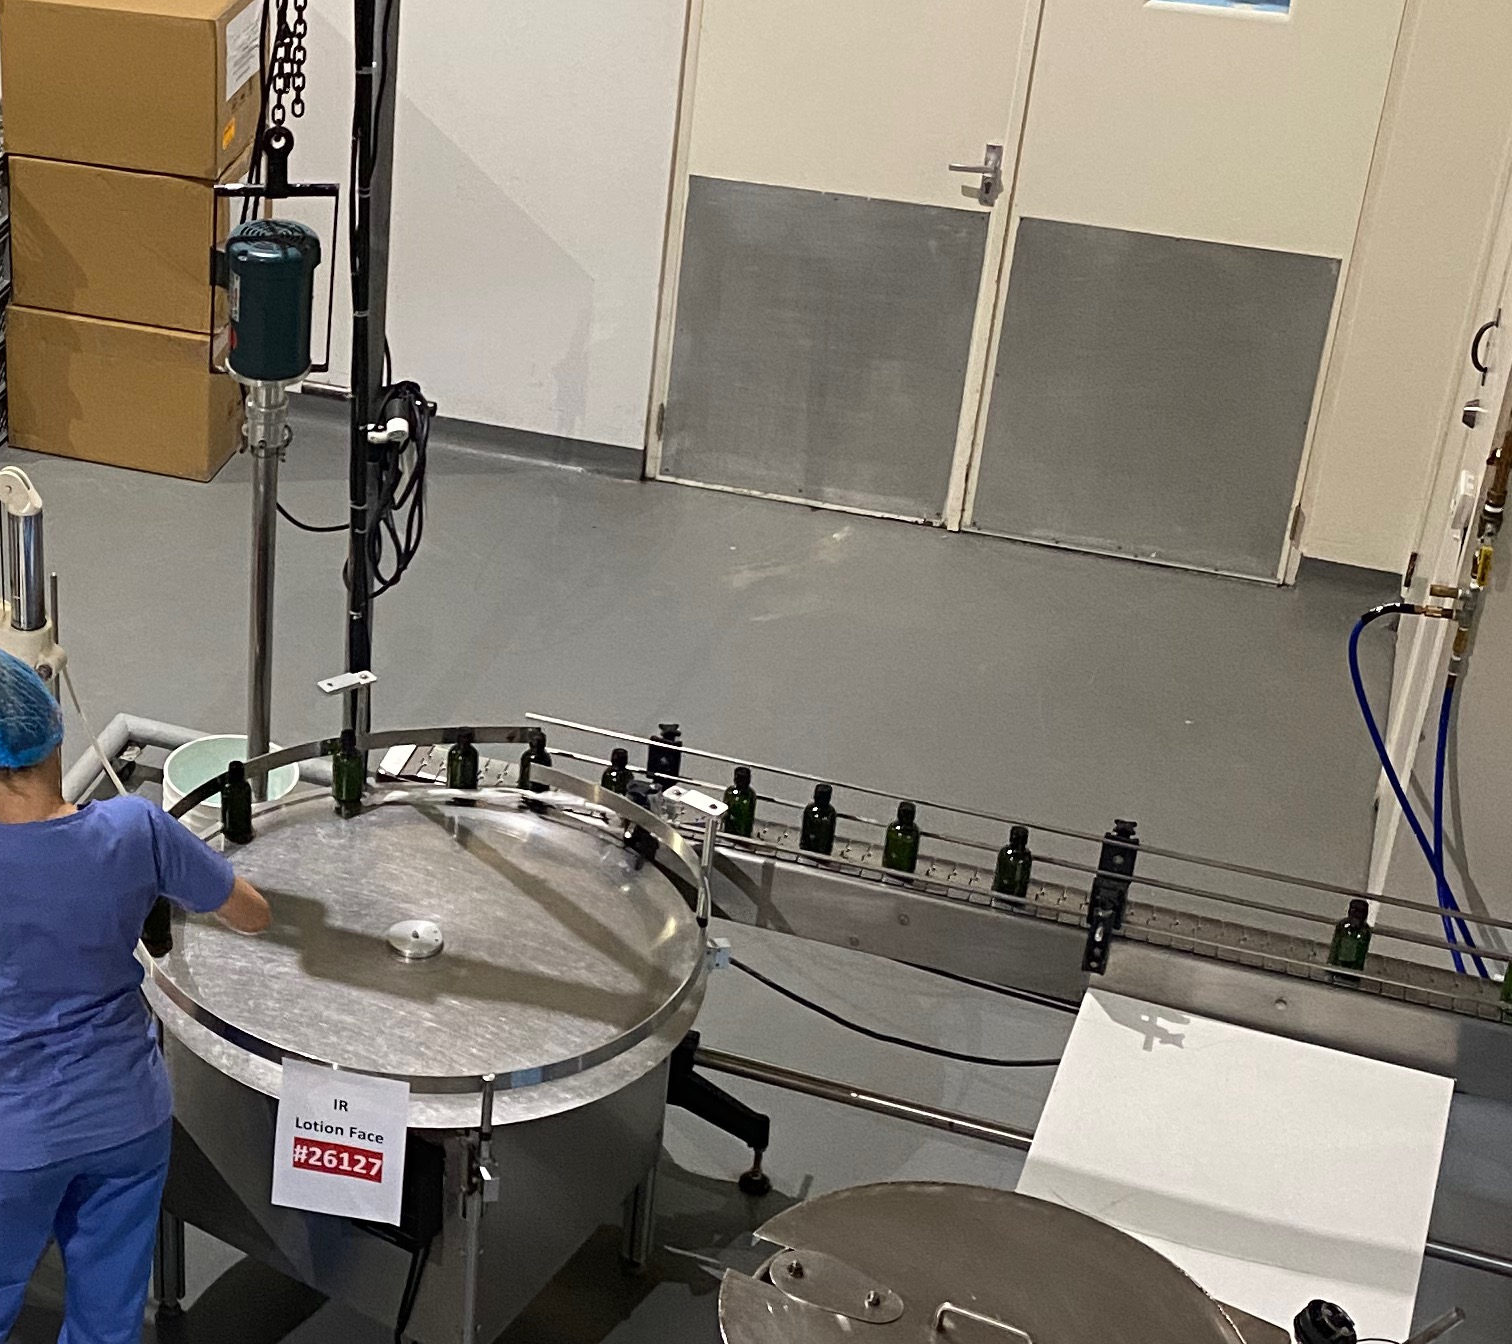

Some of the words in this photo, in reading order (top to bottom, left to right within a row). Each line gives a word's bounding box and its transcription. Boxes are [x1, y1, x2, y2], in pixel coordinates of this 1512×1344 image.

[333, 1099, 348, 1112] IR
[295, 1116, 344, 1136] Lotion
[349, 1126, 384, 1144] Face
[293, 1144, 383, 1176] #26127
